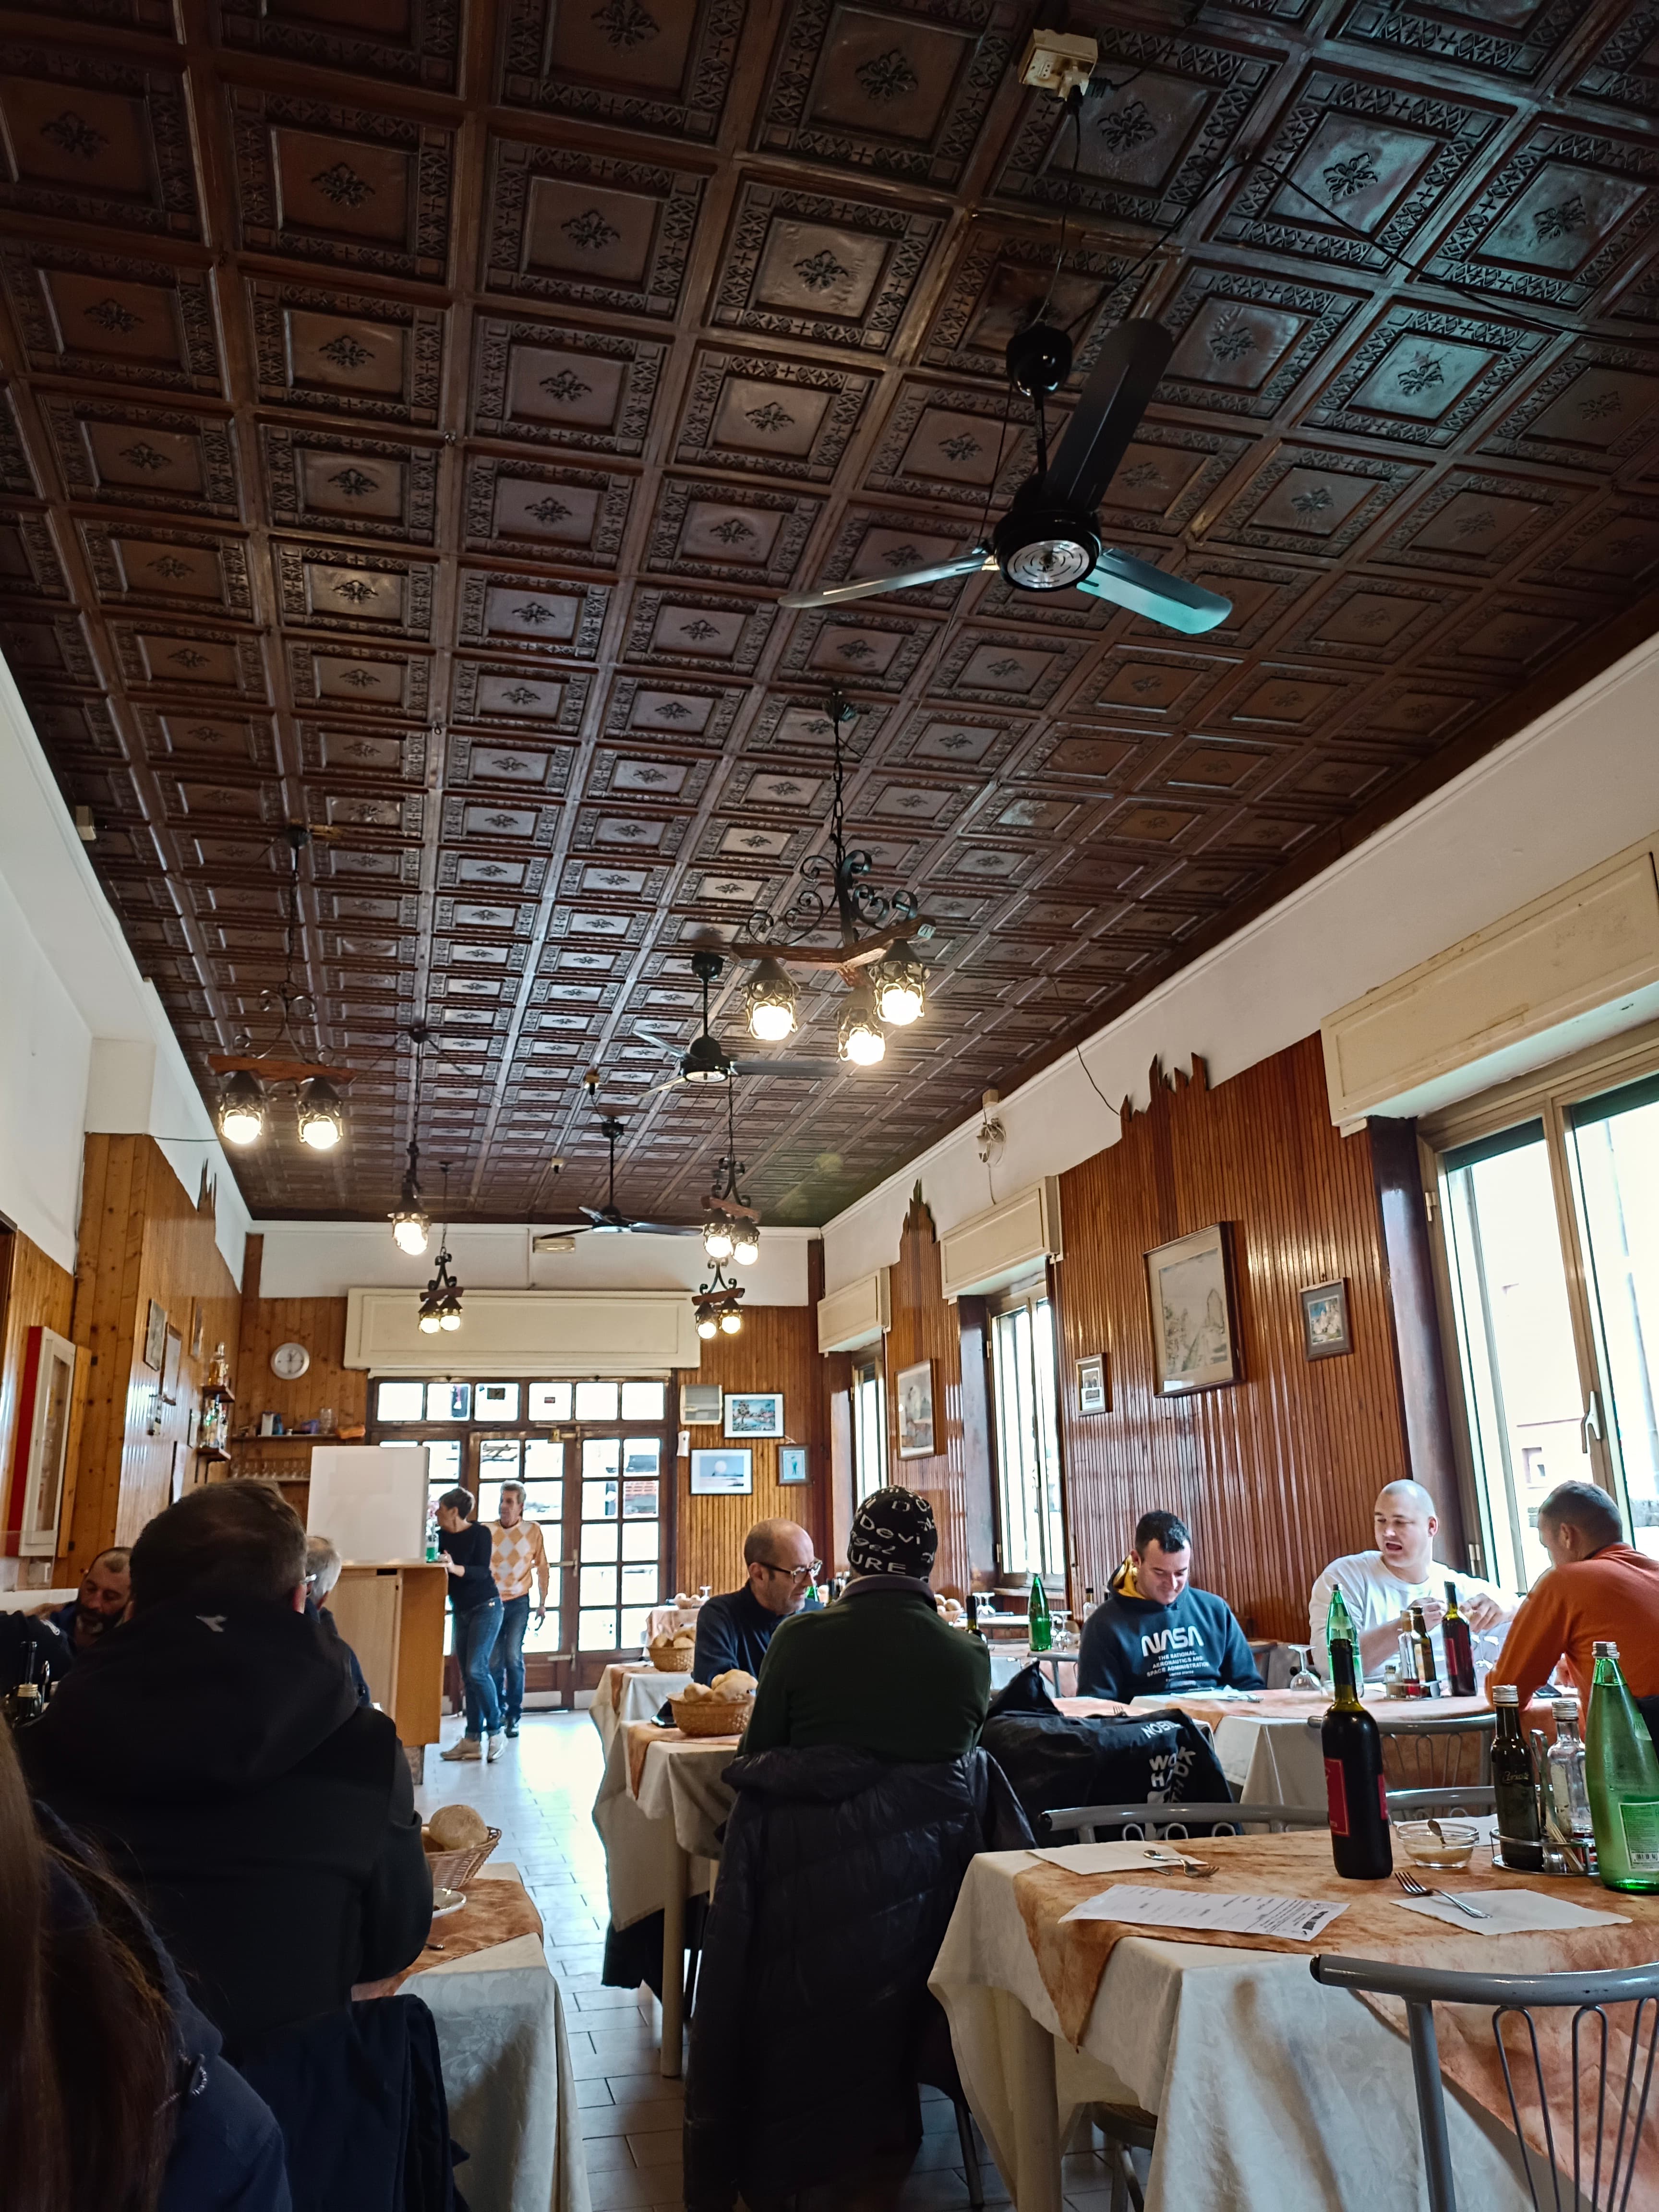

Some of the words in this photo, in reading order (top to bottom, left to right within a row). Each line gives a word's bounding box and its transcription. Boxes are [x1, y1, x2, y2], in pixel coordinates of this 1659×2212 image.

[1141, 1625, 1204, 1657] NASA
[1170, 1650, 1197, 1659] NATIONAL
[1153, 1657, 1191, 1669] AERONAUTICS
[1146, 1668, 1166, 1677] SPACE
